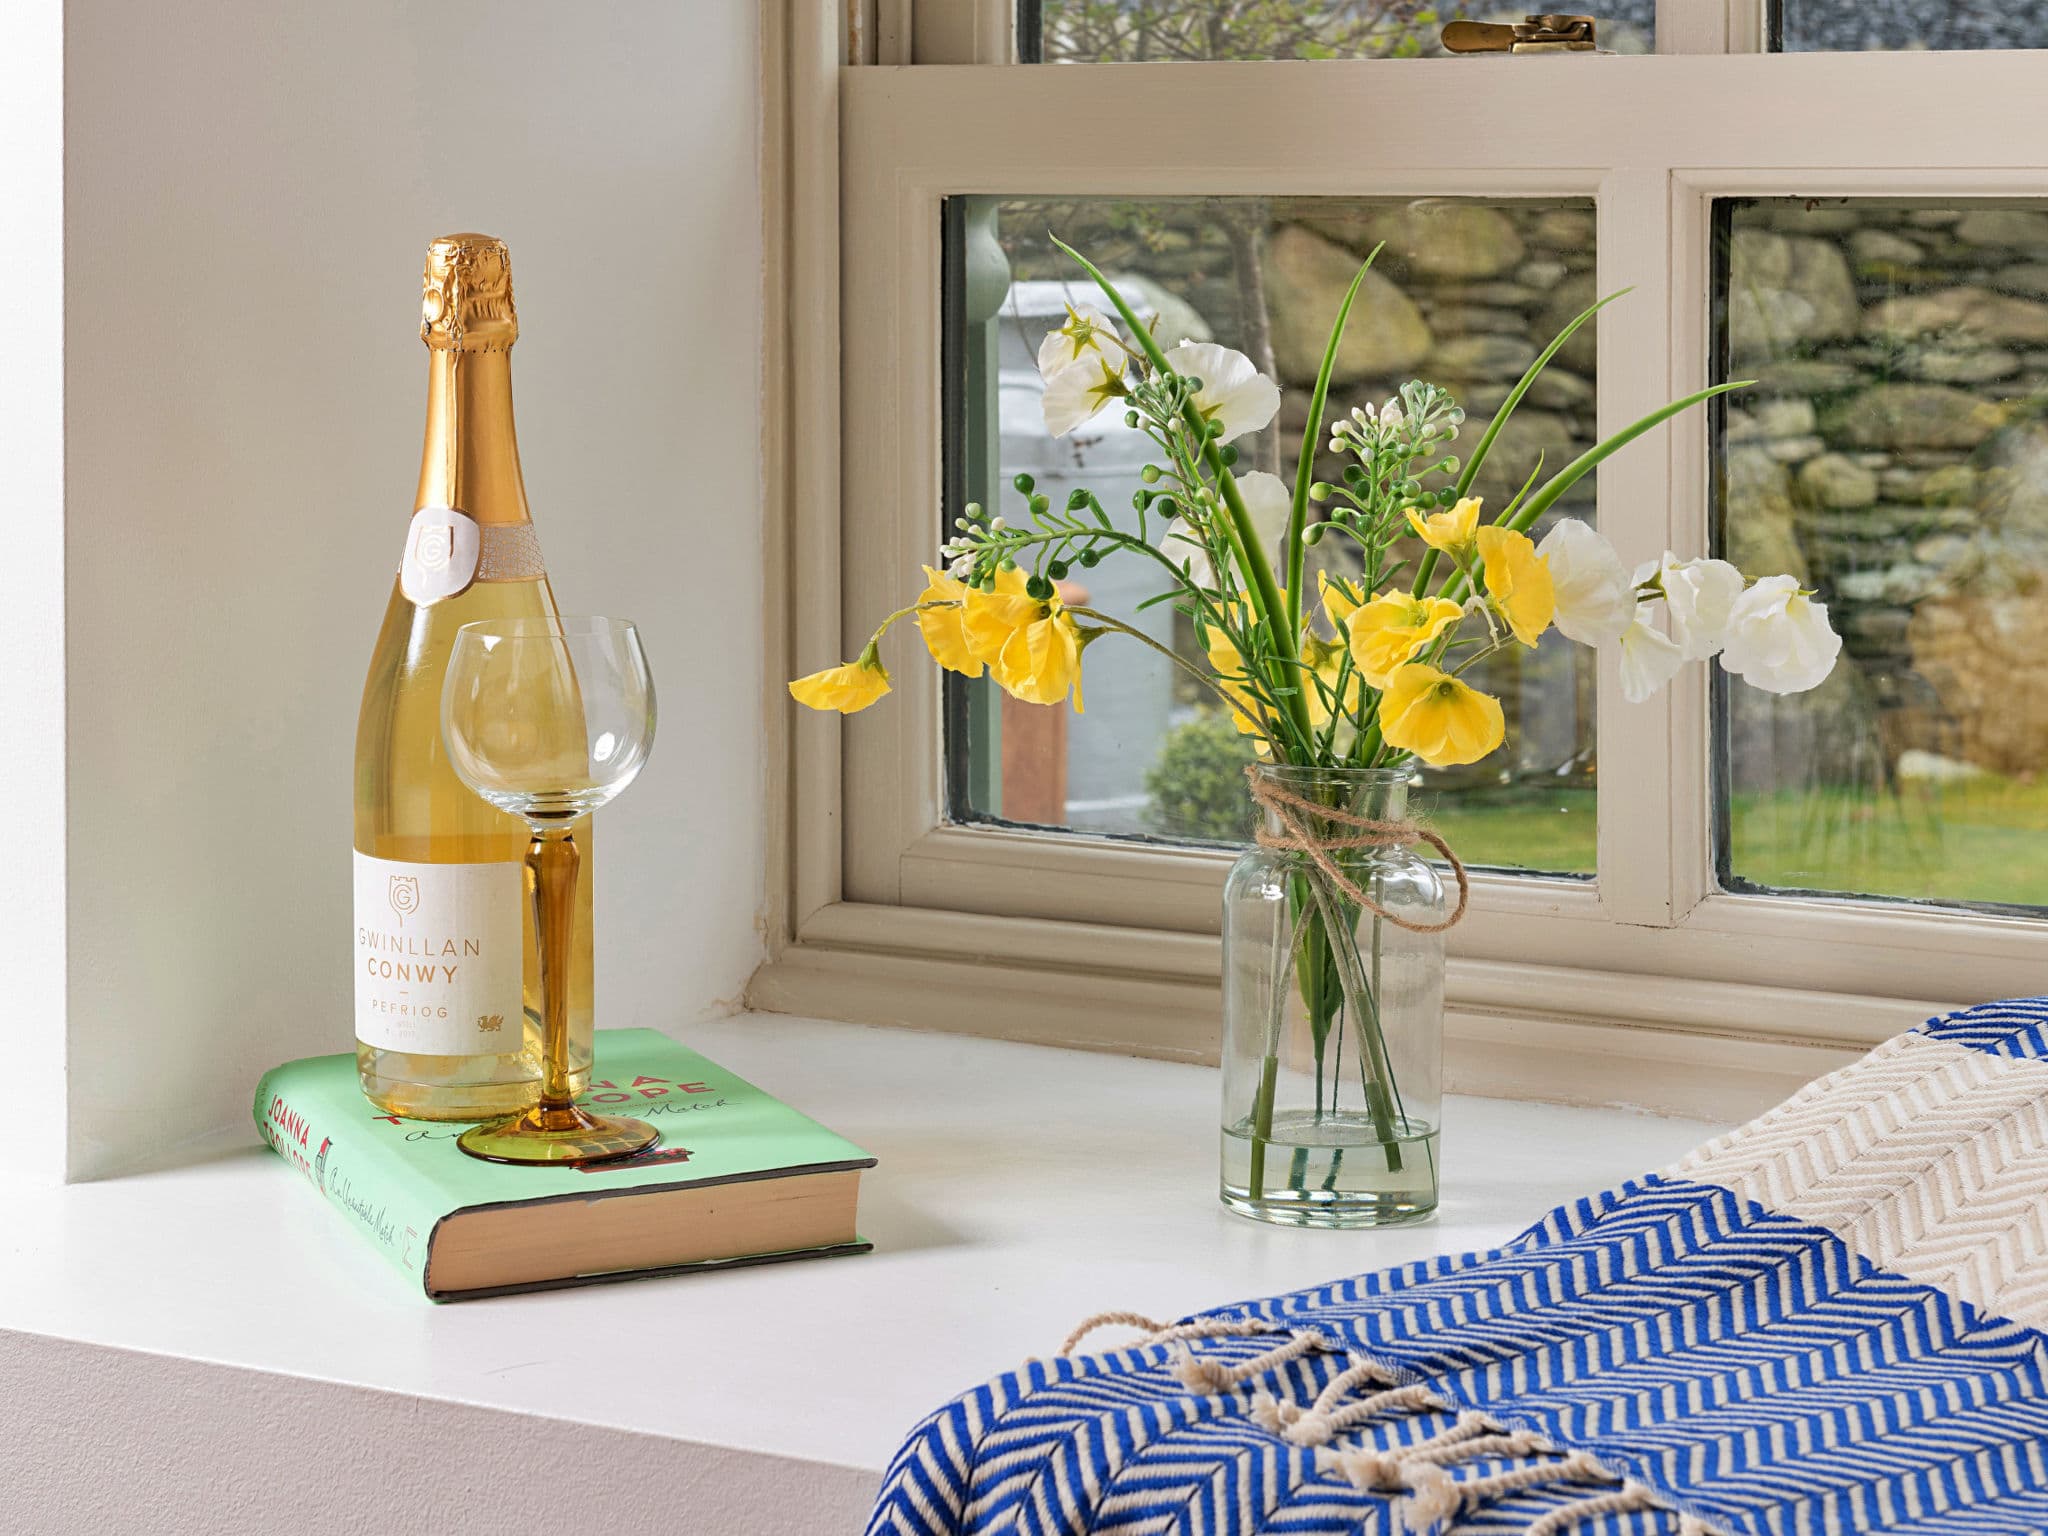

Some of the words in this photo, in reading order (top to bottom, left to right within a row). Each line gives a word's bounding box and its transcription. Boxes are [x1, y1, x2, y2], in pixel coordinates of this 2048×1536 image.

[359, 927, 480, 956] GWINLLAN
[367, 957, 458, 984] CONWY
[372, 999, 448, 1018] PEFRIOG
[645, 1099, 742, 1118] Match
[268, 1094, 311, 1151] JOANNA
